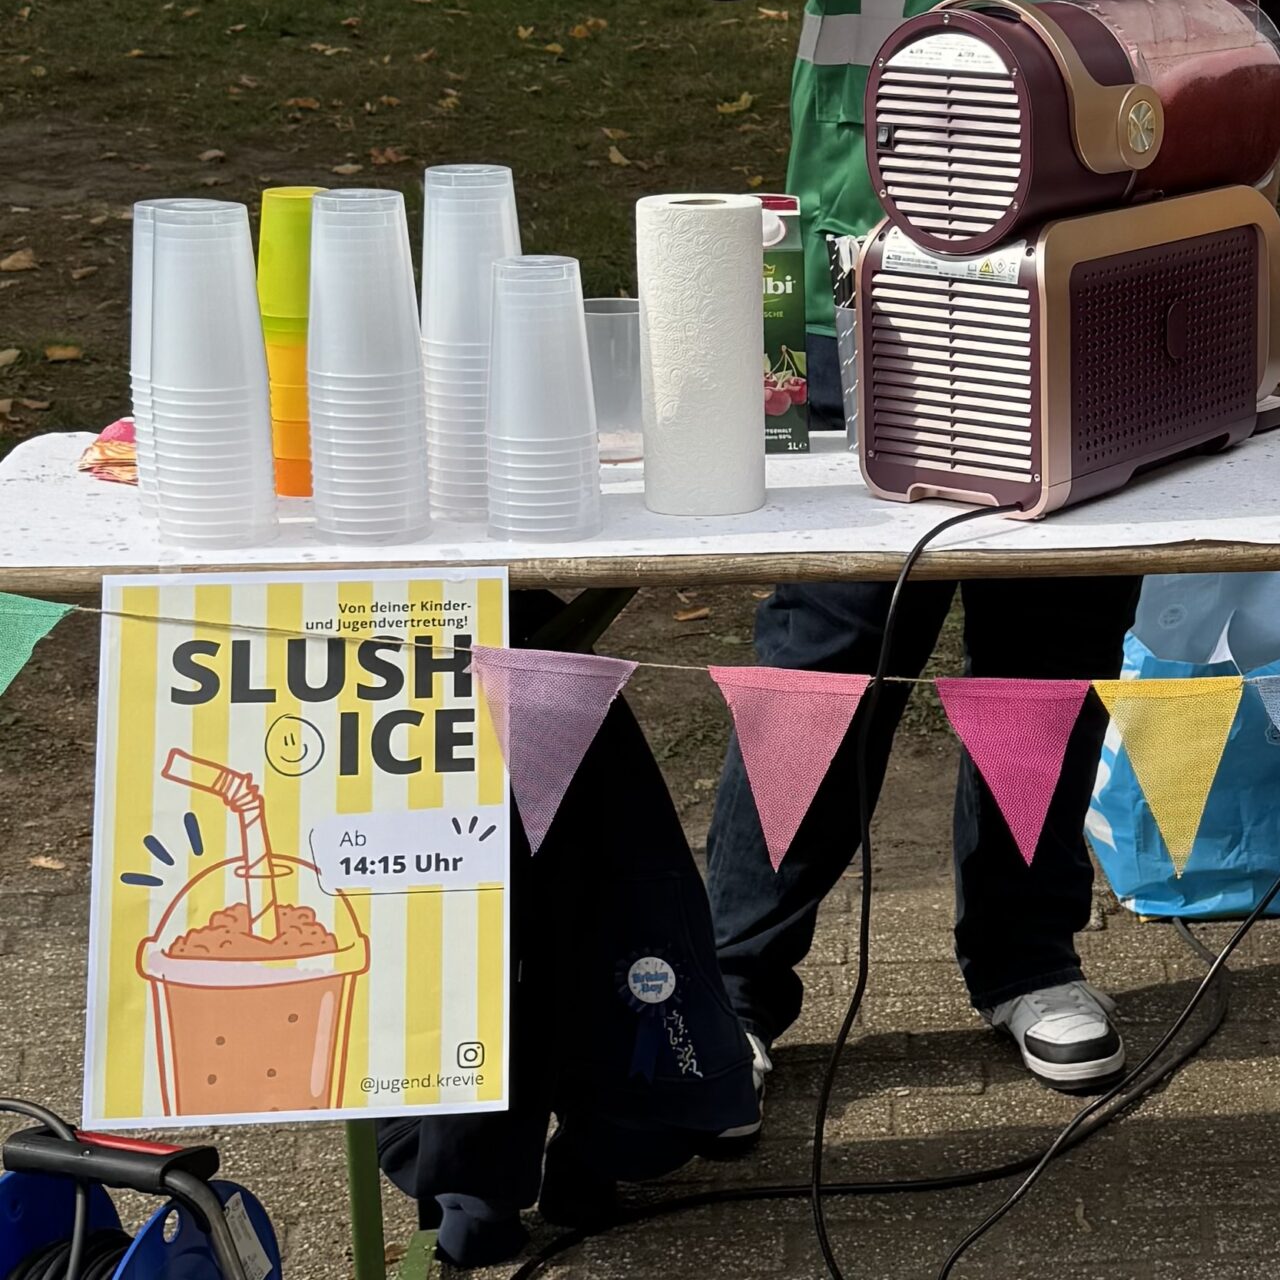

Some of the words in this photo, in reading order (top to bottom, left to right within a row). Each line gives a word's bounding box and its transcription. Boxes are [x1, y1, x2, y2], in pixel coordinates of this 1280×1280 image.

[339, 602, 367, 615] Von
[370, 601, 417, 614] deiner
[420, 600, 472, 613] Kinder-
[305, 620, 334, 631] und
[336, 616, 468, 632] Jugendvertretung!
[170, 634, 473, 706] SLUSH
[338, 708, 476, 777] ICE
[339, 831, 367, 848] Ab
[339, 855, 407, 876] 14:15
[415, 854, 464, 874] Uhr
[360, 1072, 485, 1094] @jugend.krevie
